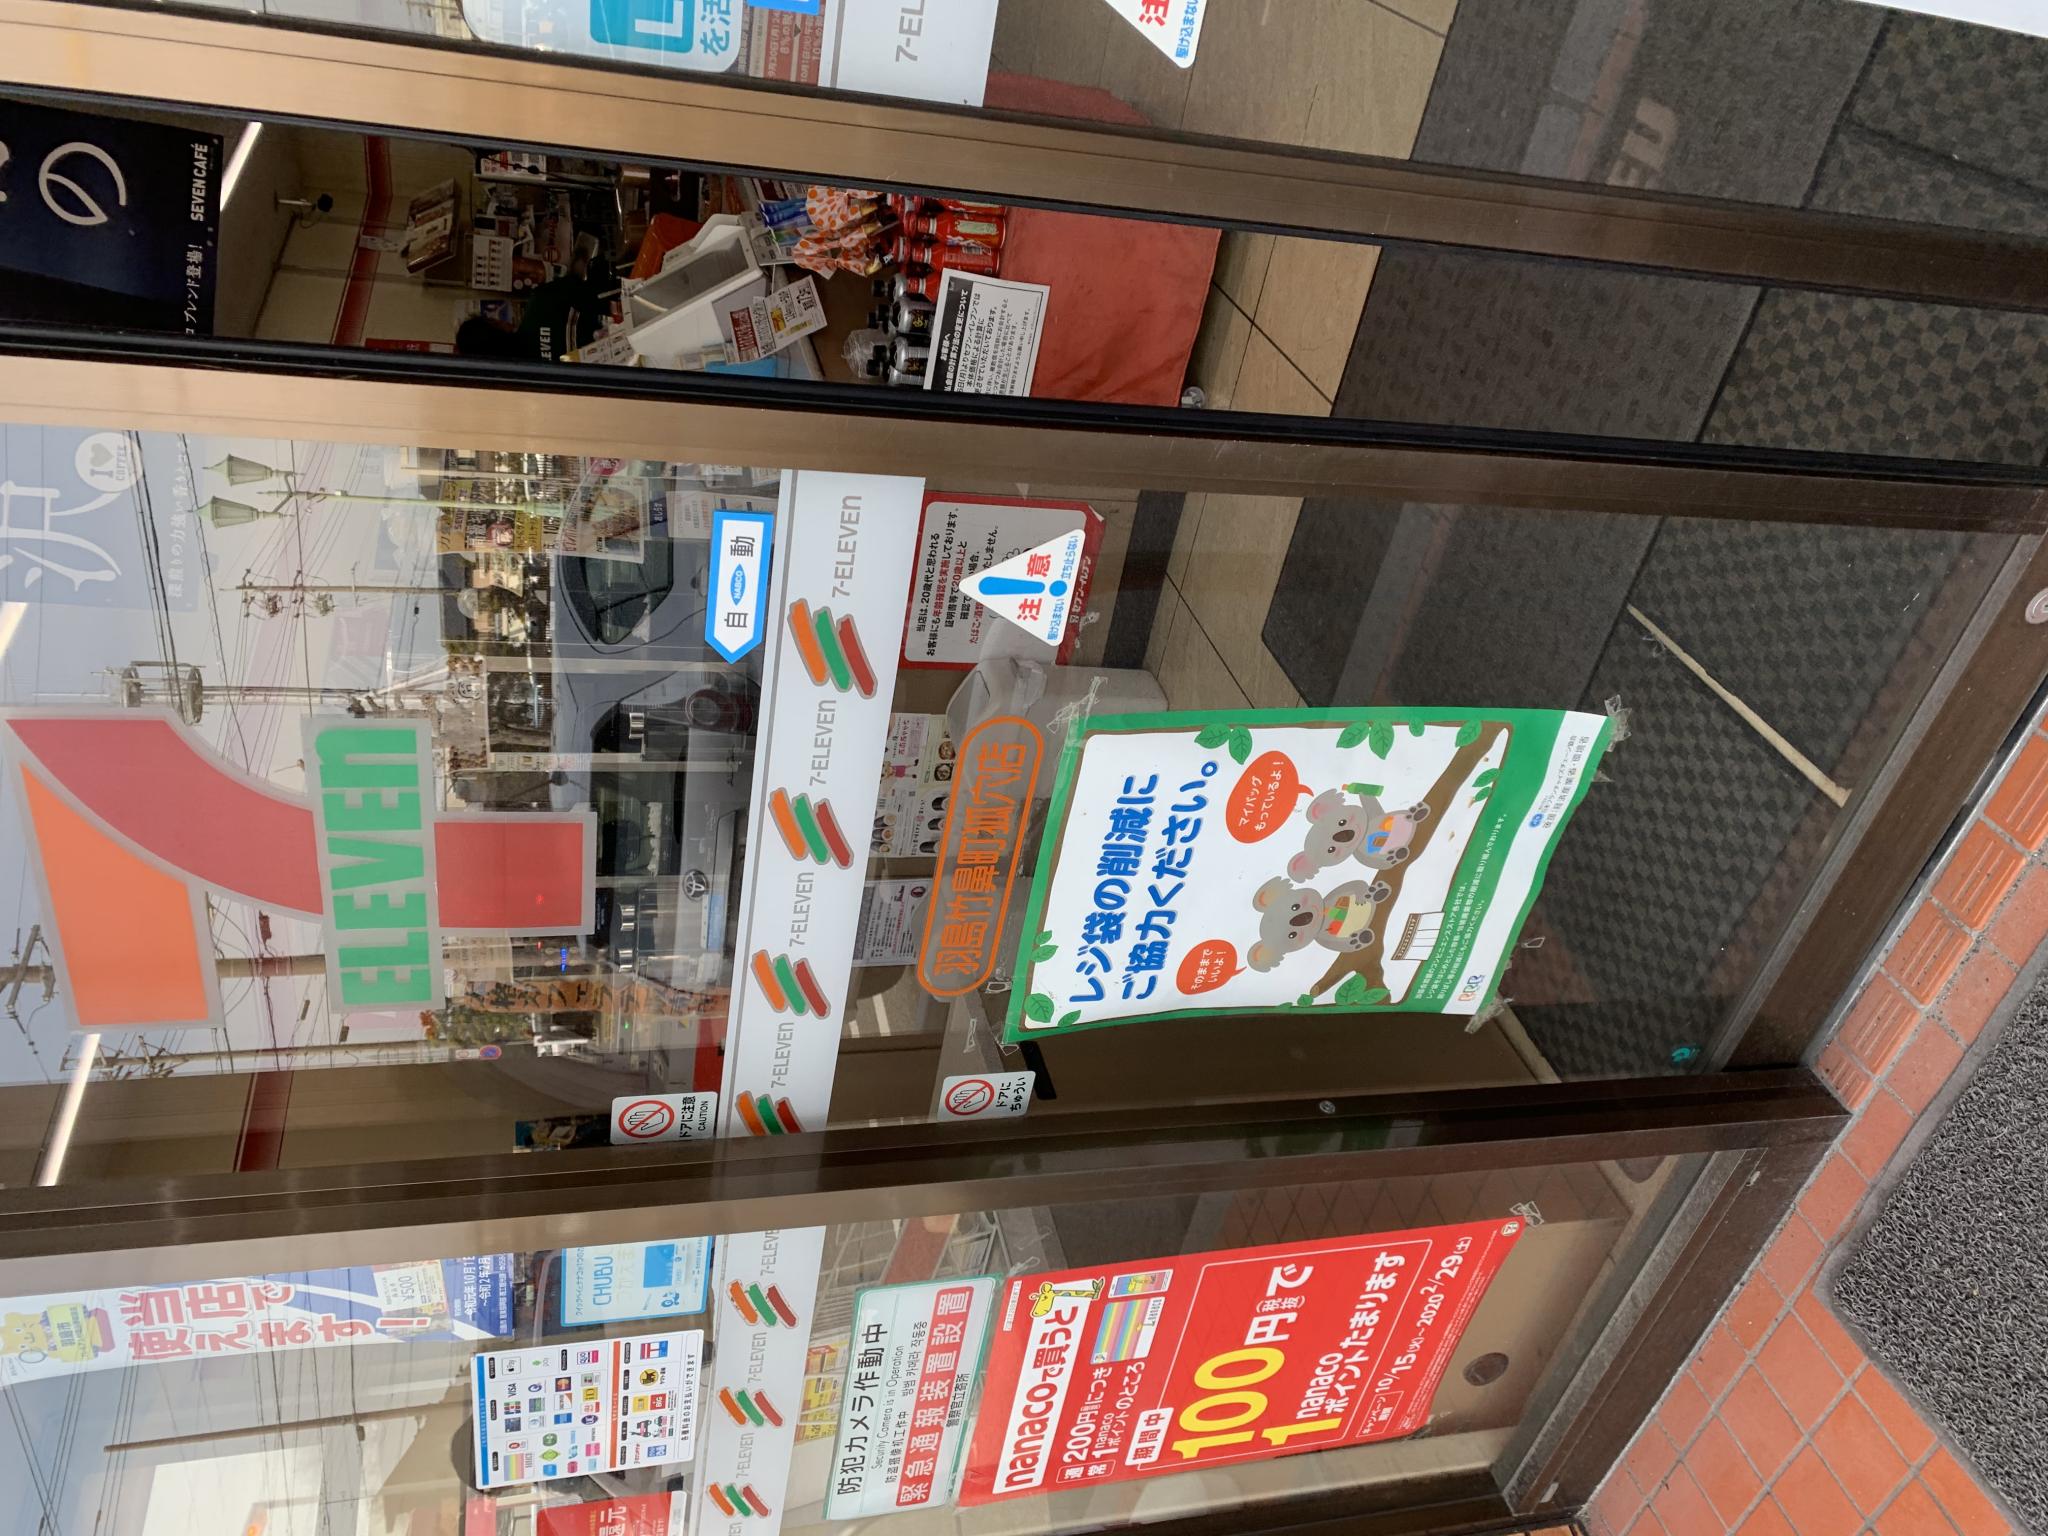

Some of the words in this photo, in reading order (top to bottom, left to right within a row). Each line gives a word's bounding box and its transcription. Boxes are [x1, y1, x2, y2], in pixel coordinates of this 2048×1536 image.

[191, 178, 206, 221] SEVEN
[733, 569, 744, 600] NABCO
[1047, 598, 1065, 640] 駆け込まない
[1061, 536, 1079, 579] 立ち止らない
[1238, 775, 1264, 826] マイバッグ
[932, 741, 1027, 977] 羽島竹鼻町狐穴店
[1120, 761, 1218, 1000] ご協力ください。
[1068, 774, 1158, 1003] レジ袋の削減に
[1190, 948, 1213, 991] そのままで
[698, 1101, 708, 1131] CAUTION
[996, 1082, 1011, 1108] ドアに
[1010, 1077, 1026, 1112] ちゅうい
[679, 1096, 695, 1138] ドアに注意
[592, 1256, 614, 1306] CHUBU
[120, 1282, 292, 1326] 当店で
[886, 1346, 904, 1386] Operation
[1296, 1353, 1343, 1419] nanaco
[508, 1383, 517, 1398] VISA
[837, 1323, 888, 1495] 防犯カメラ作動中
[899, 1291, 970, 1503] 緊急通報装置設置
[946, 1373, 970, 1428] 警察官立寄所
[1004, 1306, 1079, 1488] nanacoで買うと
[878, 1408, 893, 1438] Camera
[1094, 1413, 1114, 1448] nanaco
[1132, 1413, 1165, 1460] 期間中
[1363, 1396, 1387, 1434] キャンペーン
[871, 1441, 888, 1469] Security
[1064, 1463, 1108, 1480] 通常
